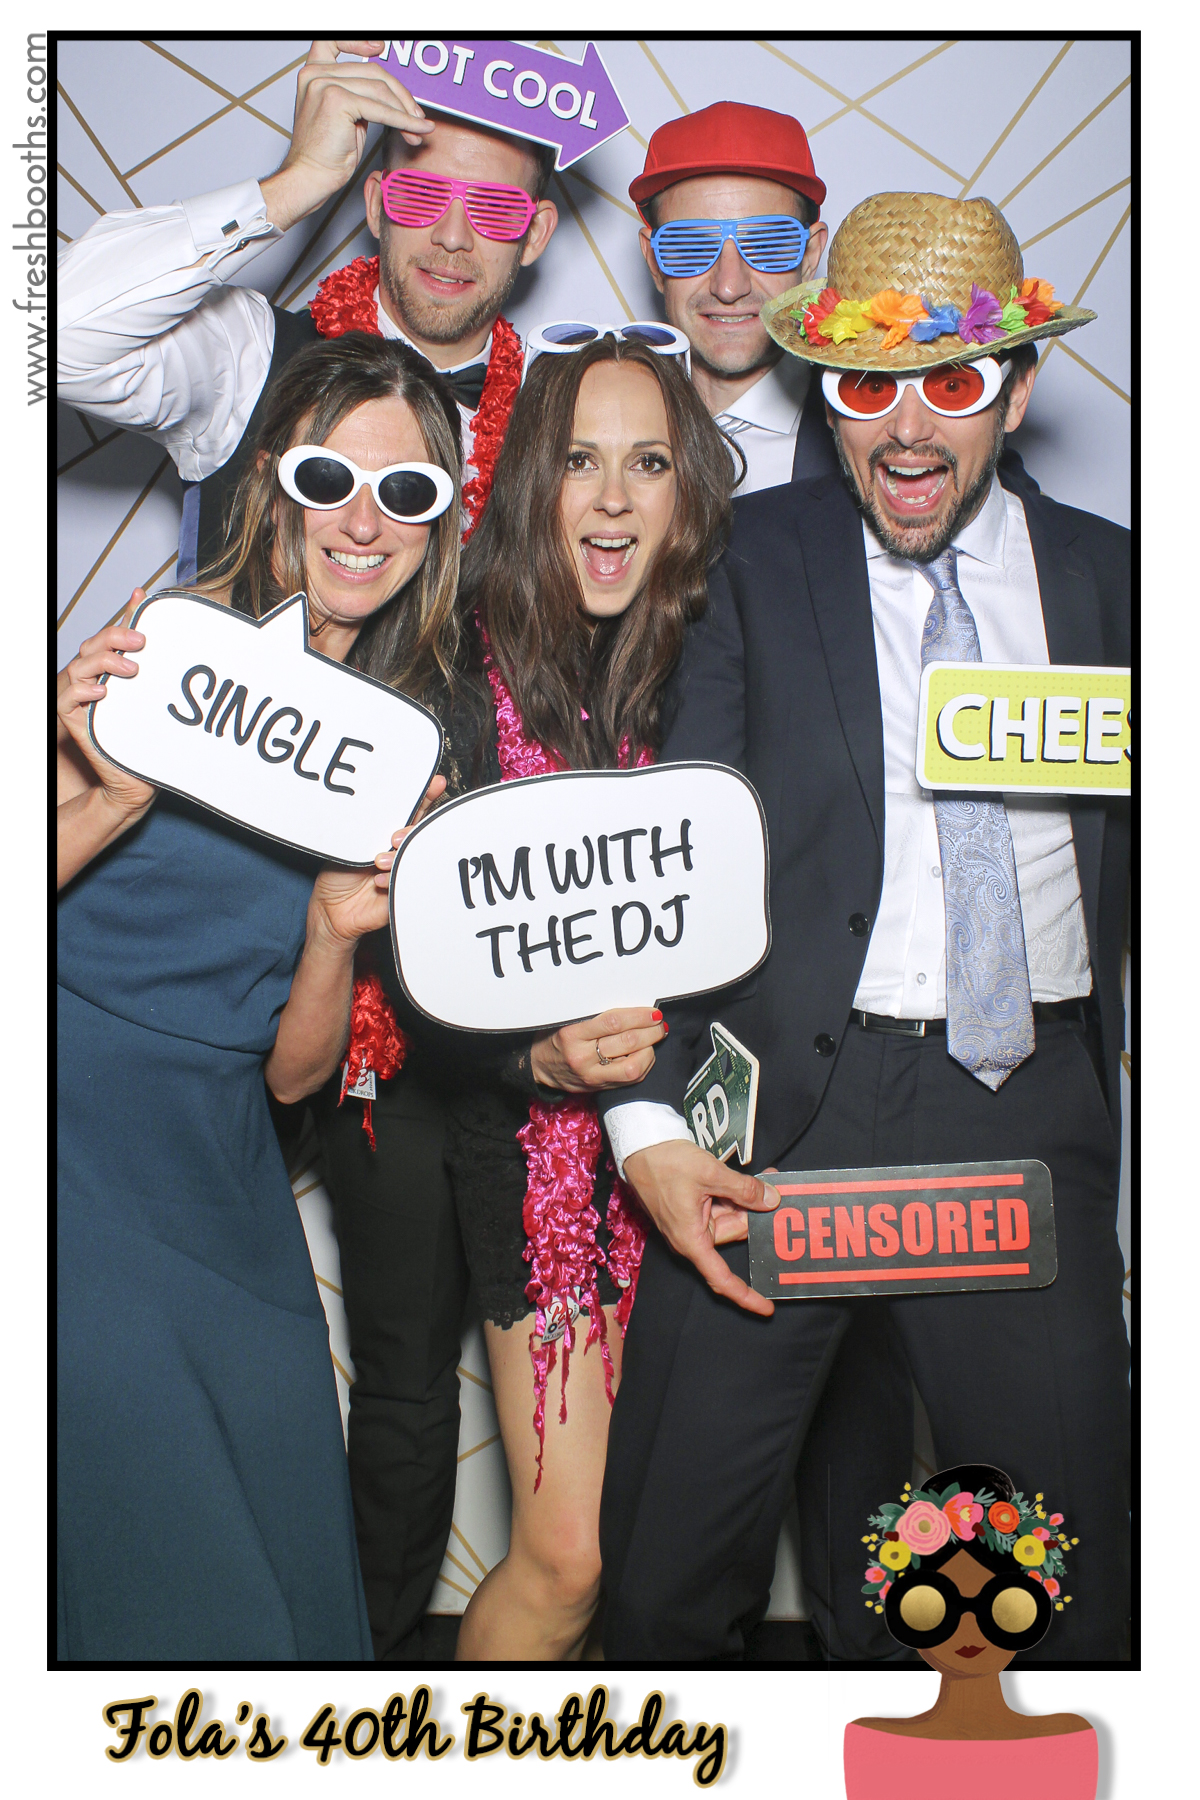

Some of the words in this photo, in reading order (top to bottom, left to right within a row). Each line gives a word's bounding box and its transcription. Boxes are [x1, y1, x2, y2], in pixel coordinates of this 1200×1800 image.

[379, 40, 475, 85] NOT
[483, 60, 598, 130] COOL
[167, 664, 374, 796] SINGLE
[936, 693, 1131, 764] CHEE
[458, 846, 536, 910] I'M
[545, 818, 694, 895] WITH
[475, 909, 604, 979] THE
[611, 894, 690, 957] DJ
[773, 1198, 1031, 1262] CENSORED
